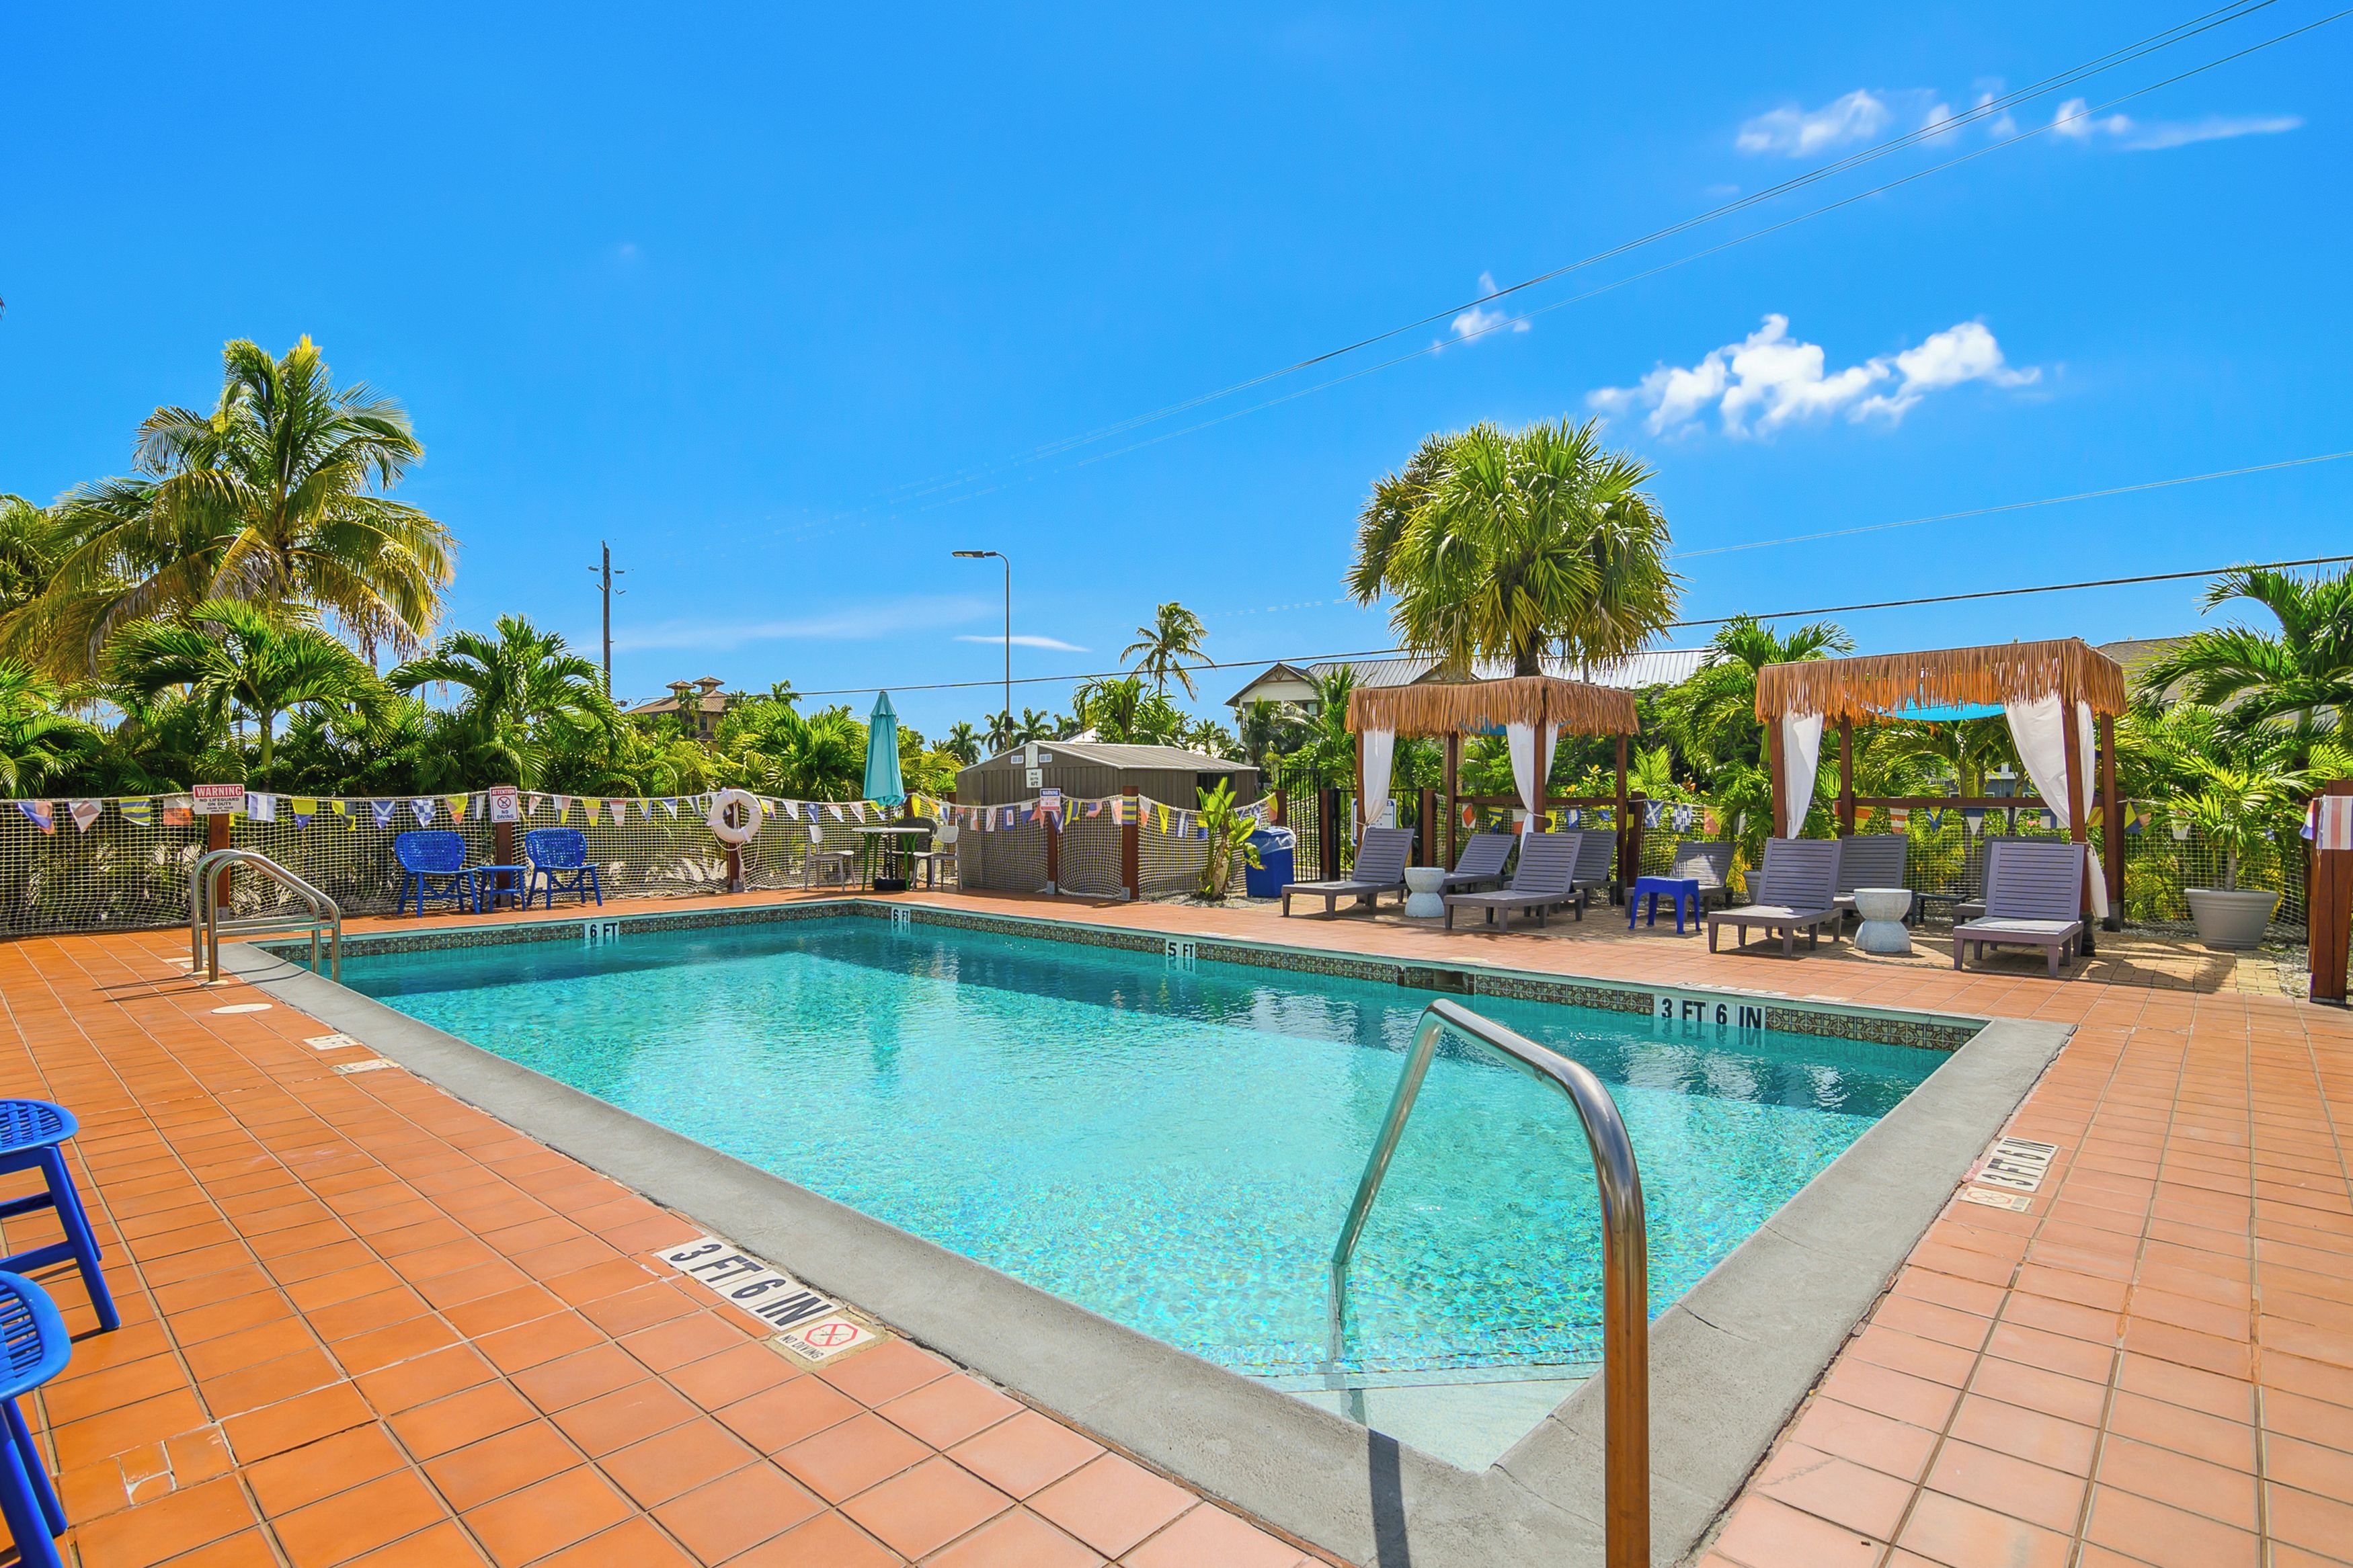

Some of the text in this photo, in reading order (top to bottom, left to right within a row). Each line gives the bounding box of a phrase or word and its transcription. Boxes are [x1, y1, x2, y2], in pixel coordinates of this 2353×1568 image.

[196, 786, 242, 797] WARNING
[893, 909, 909, 921] 6 FT
[590, 922, 618, 938] 6 FT
[1168, 942, 1194, 958] 5 FT
[1661, 998, 1762, 1029] 3 FT 6 IN
[2002, 1137, 2055, 1153] IN
[1997, 1149, 2046, 1161] 6
[1987, 1158, 2043, 1178] FT
[1981, 1173, 2034, 1186] 3
[670, 1244, 833, 1327] 3 FT 6 IN
[780, 1334, 825, 1359] NO DIVING
